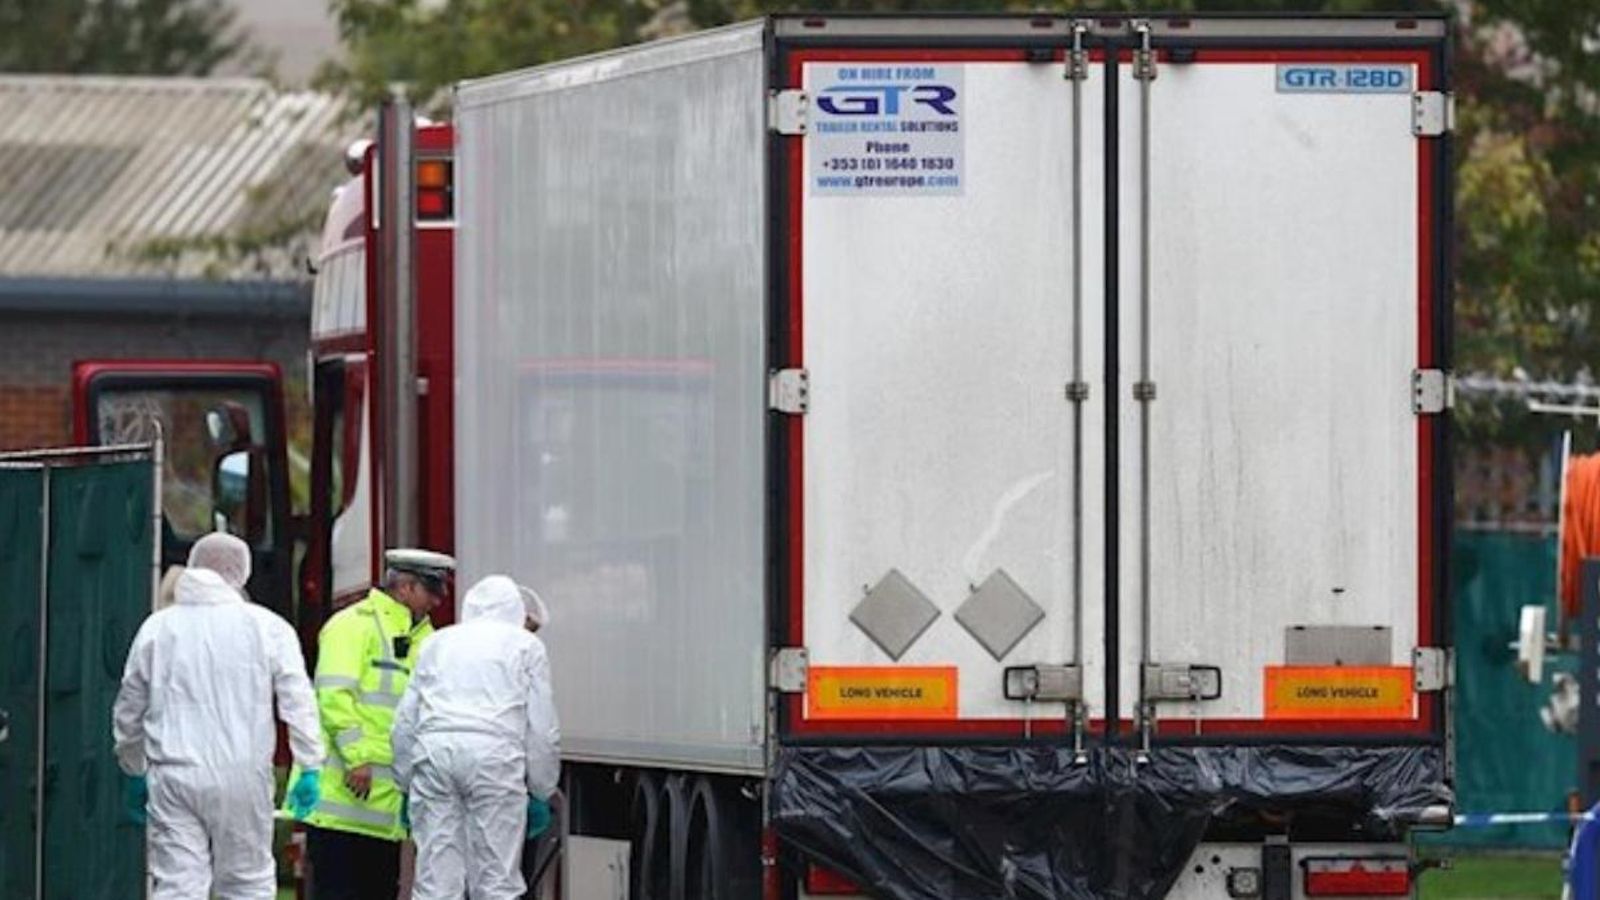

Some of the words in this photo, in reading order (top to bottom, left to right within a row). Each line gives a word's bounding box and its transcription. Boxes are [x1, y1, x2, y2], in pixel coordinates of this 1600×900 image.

[897, 67, 935, 80] FROM
[816, 85, 957, 115] GTR
[901, 121, 959, 133] SOLUTIONS
[866, 141, 910, 153] Phone
[823, 158, 858, 170] +353
[840, 687, 871, 698] LONG
[875, 687, 922, 698] VEHICLE
[1297, 686, 1328, 698] LONG
[1332, 687, 1379, 698] VEHICLE
